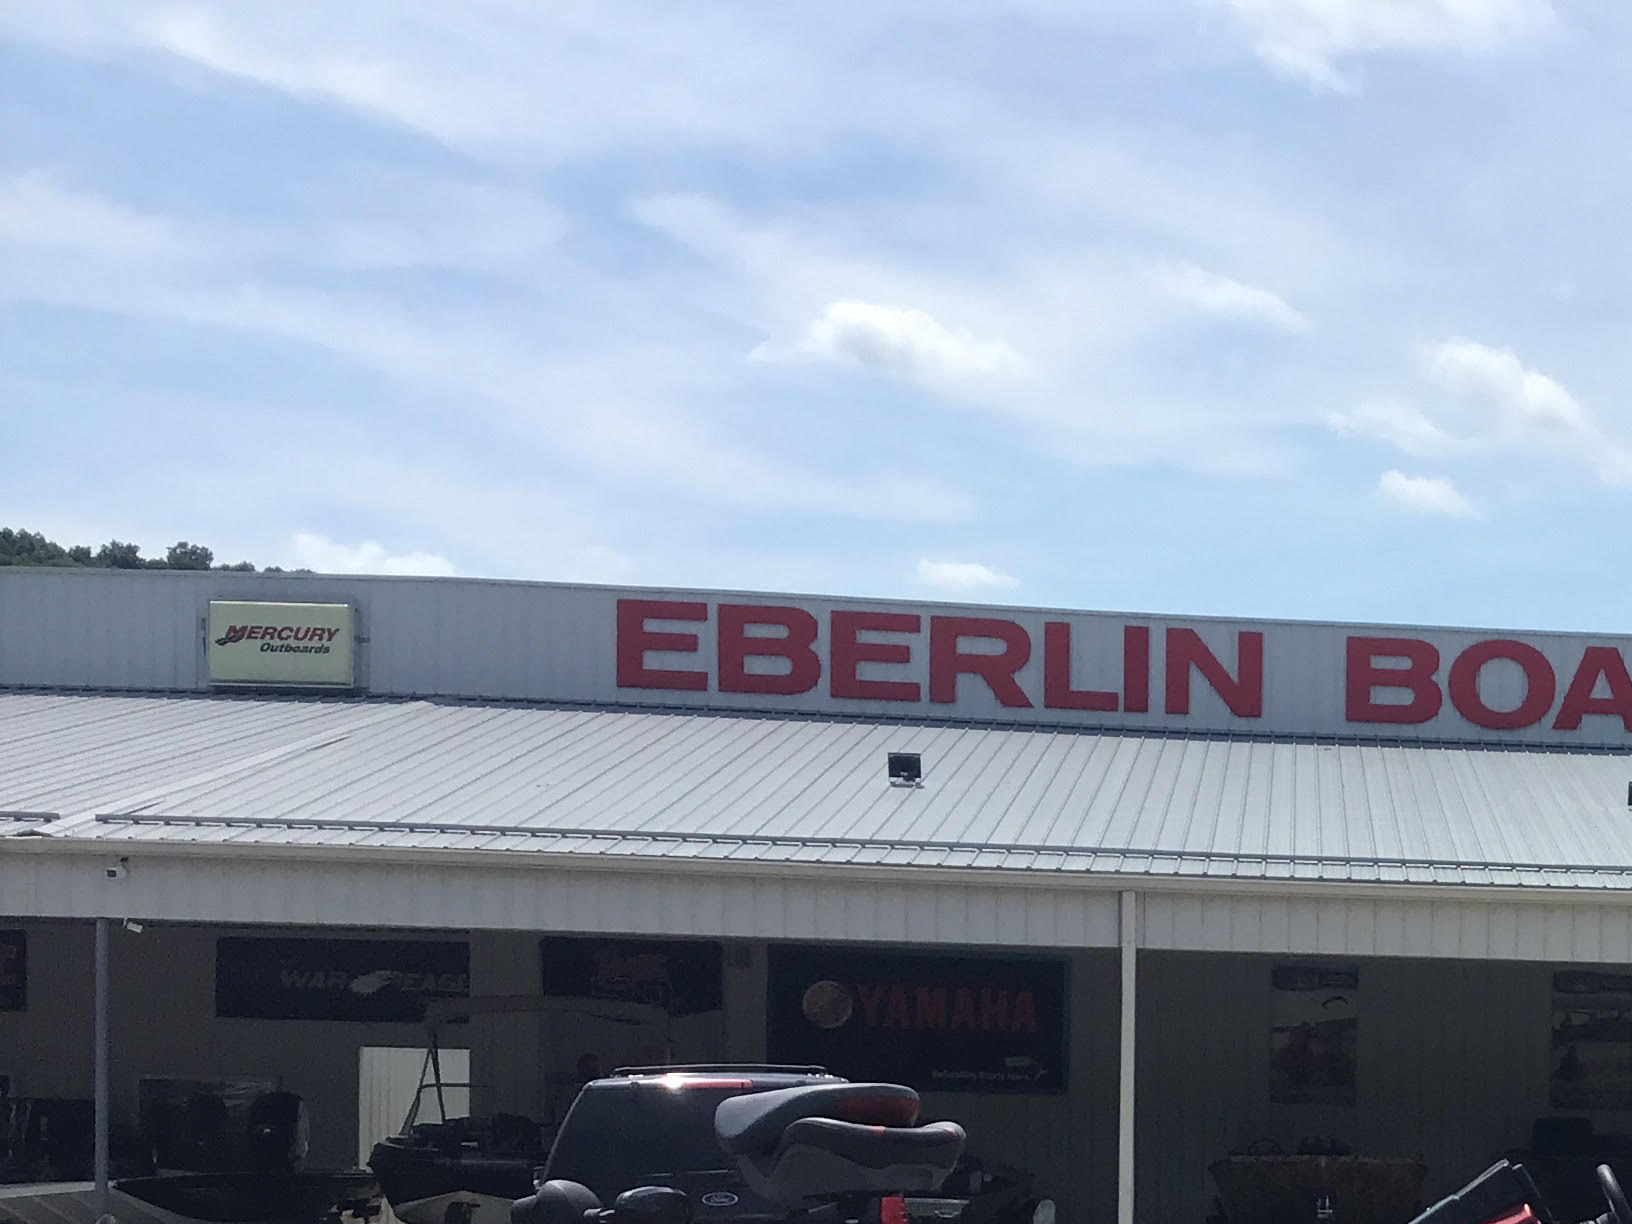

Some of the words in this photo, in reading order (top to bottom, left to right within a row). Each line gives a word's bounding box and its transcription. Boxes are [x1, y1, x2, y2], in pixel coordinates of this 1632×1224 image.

[224, 625, 340, 642] MERCURY
[260, 642, 331, 655] Outboards
[616, 599, 1264, 719] EBERLIN
[856, 984, 1039, 1032] YAMAHA
